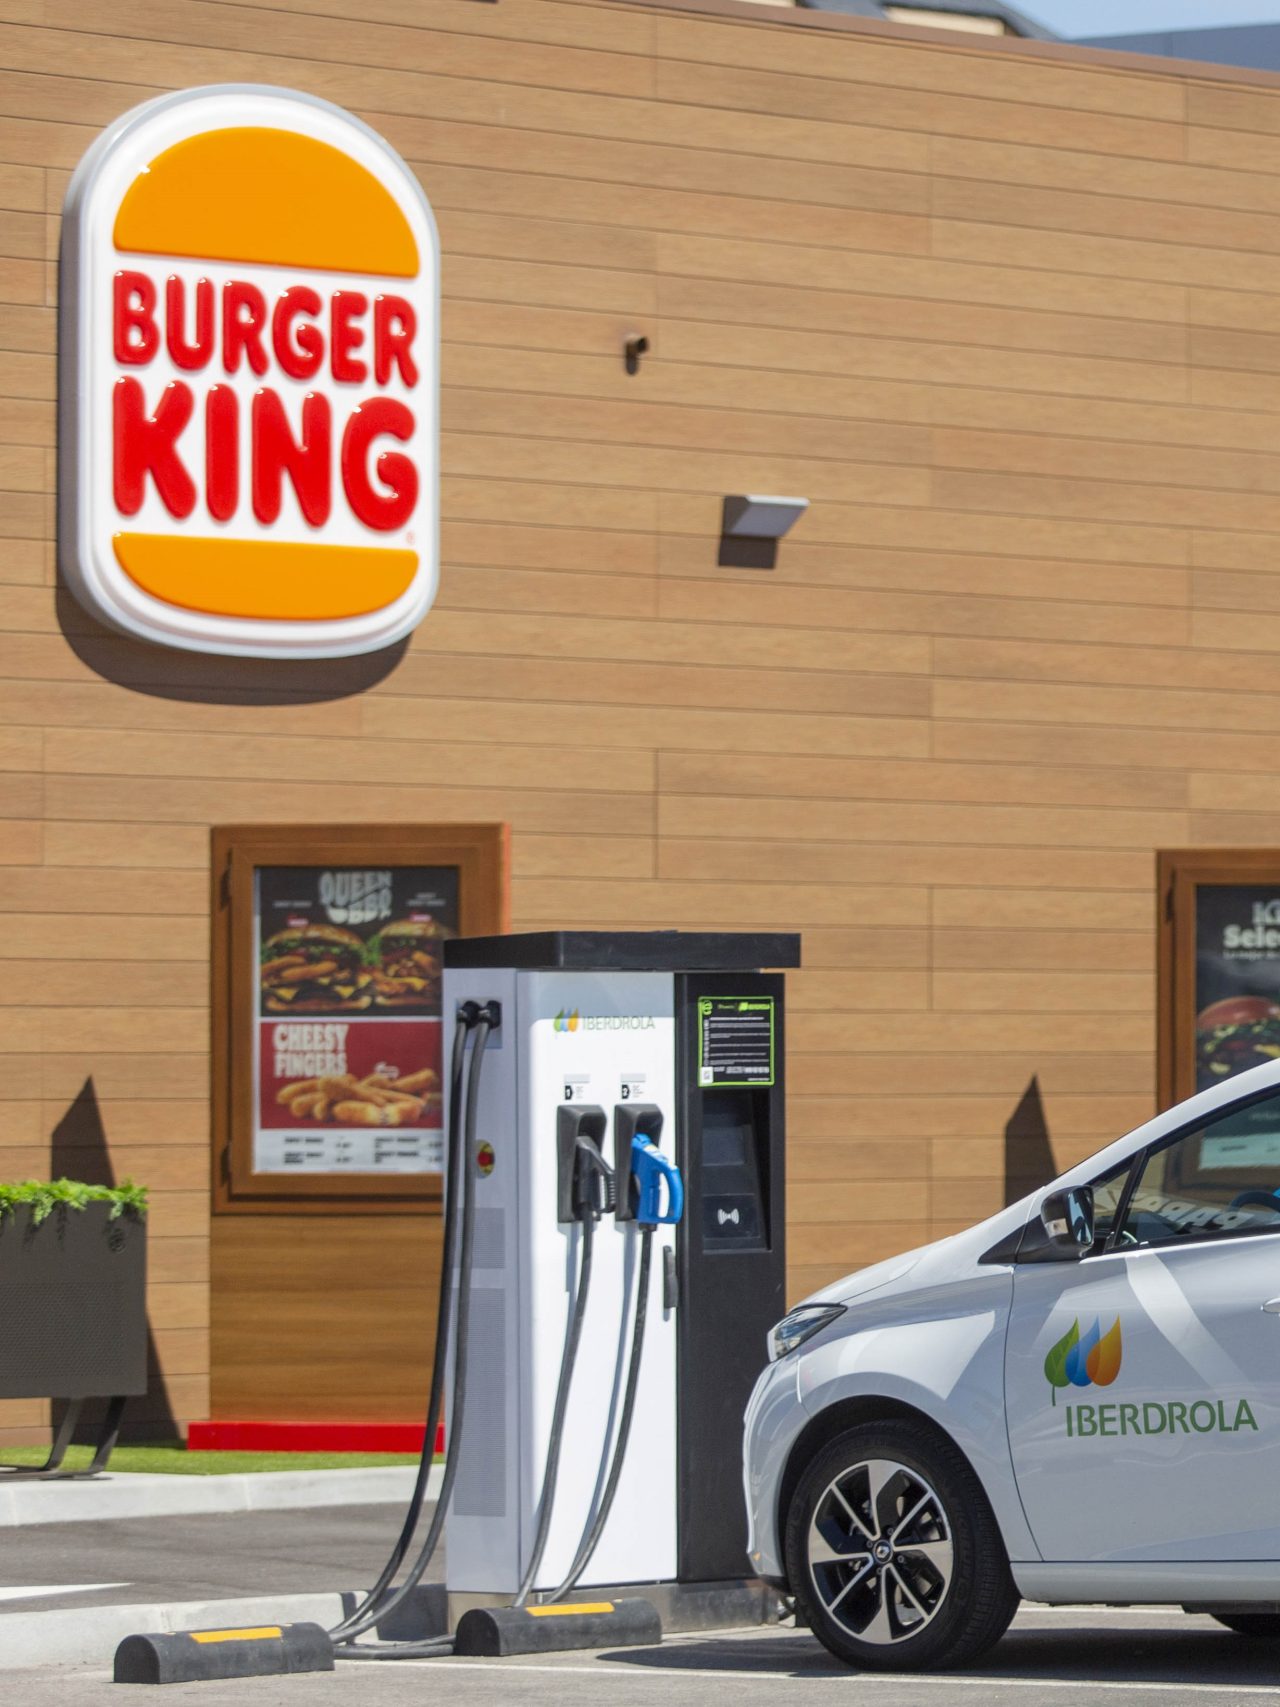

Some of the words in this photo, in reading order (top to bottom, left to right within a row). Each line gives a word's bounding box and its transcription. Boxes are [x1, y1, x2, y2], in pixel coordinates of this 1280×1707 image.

[112, 269, 420, 389] BURGER
[112, 376, 420, 532] KING
[319, 871, 392, 906] QUEEN
[273, 1023, 349, 1050] CHEESY
[582, 1016, 656, 1031] IBERDROLA
[274, 1052, 347, 1077] FINGERS
[1065, 1398, 1259, 1438] IBERDROLA
